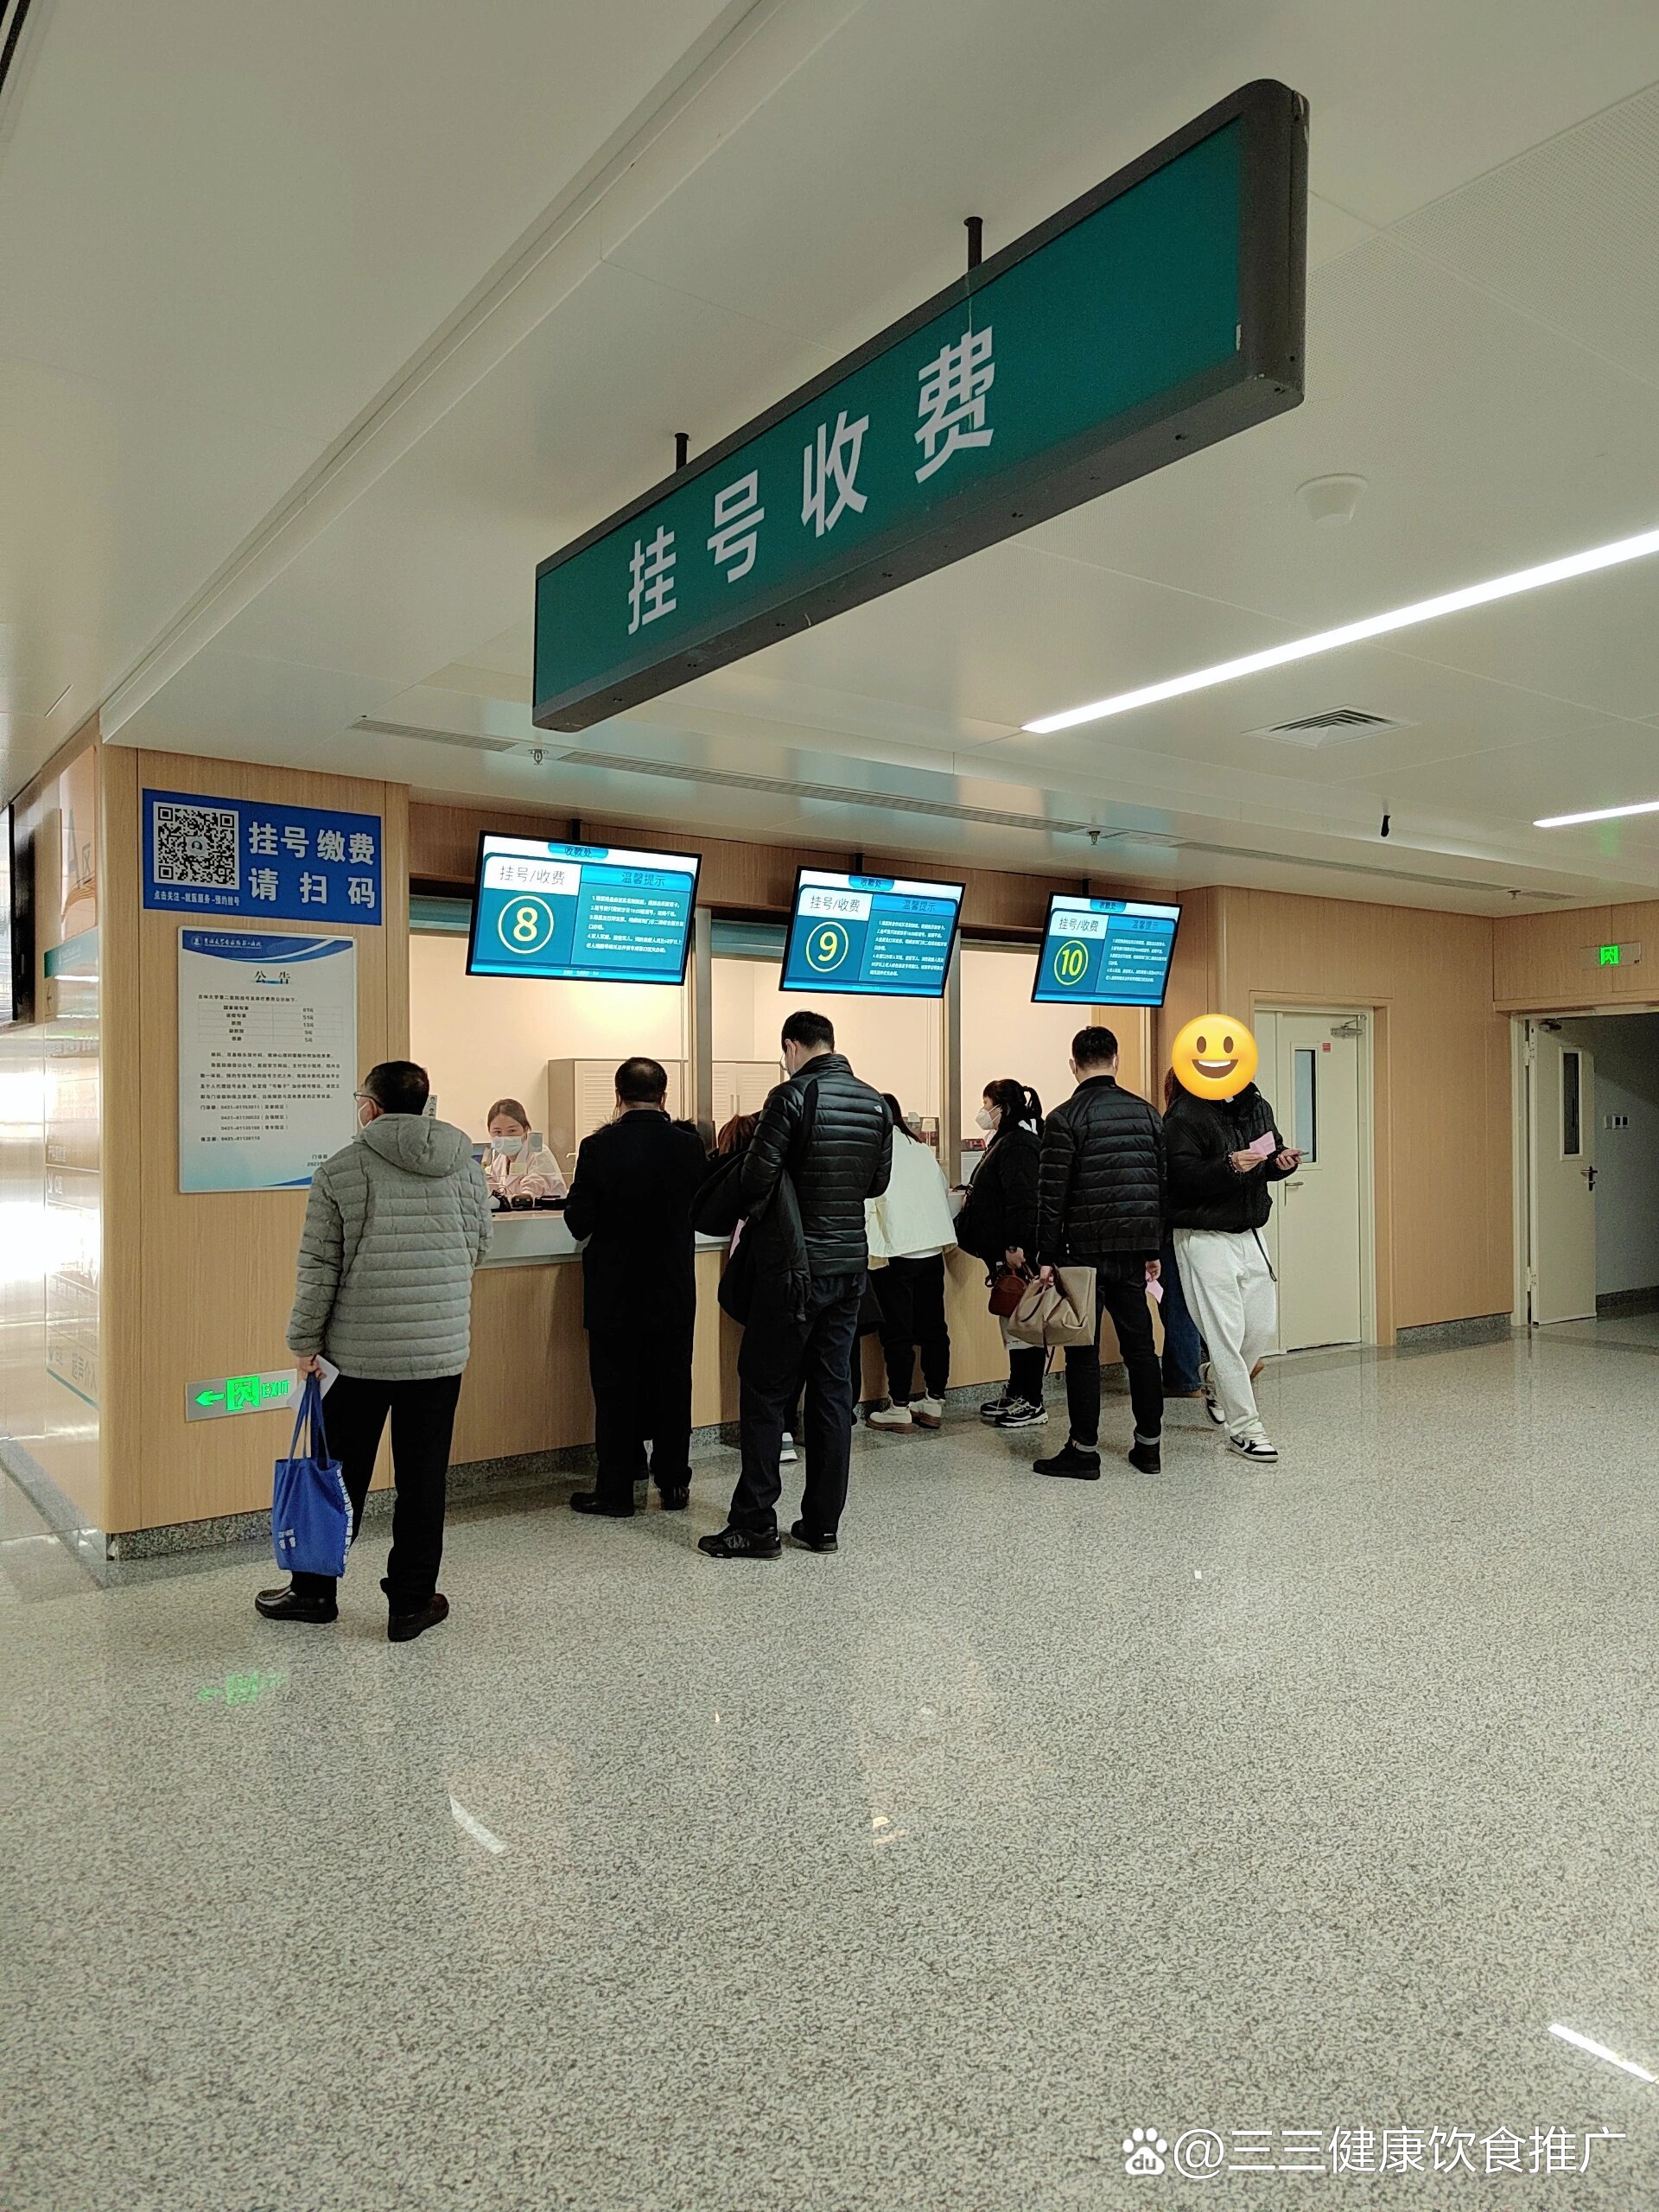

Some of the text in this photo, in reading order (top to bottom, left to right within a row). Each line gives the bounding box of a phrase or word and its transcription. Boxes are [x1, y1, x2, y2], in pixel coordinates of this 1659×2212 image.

[627, 326, 995, 635] 挂号收费
[248, 822, 375, 866] 挂号缴费
[248, 868, 375, 908] 请扫码
[499, 865, 565, 886] 挂号/收费
[621, 871, 666, 887] 温馨提示
[810, 895, 861, 913] 挂号/收费
[512, 906, 538, 942] 8
[1058, 917, 1099, 932] 挂号/收费
[817, 931, 838, 962] 9
[1061, 949, 1083, 976] 10
[262, 1379, 290, 1399] EXIT
